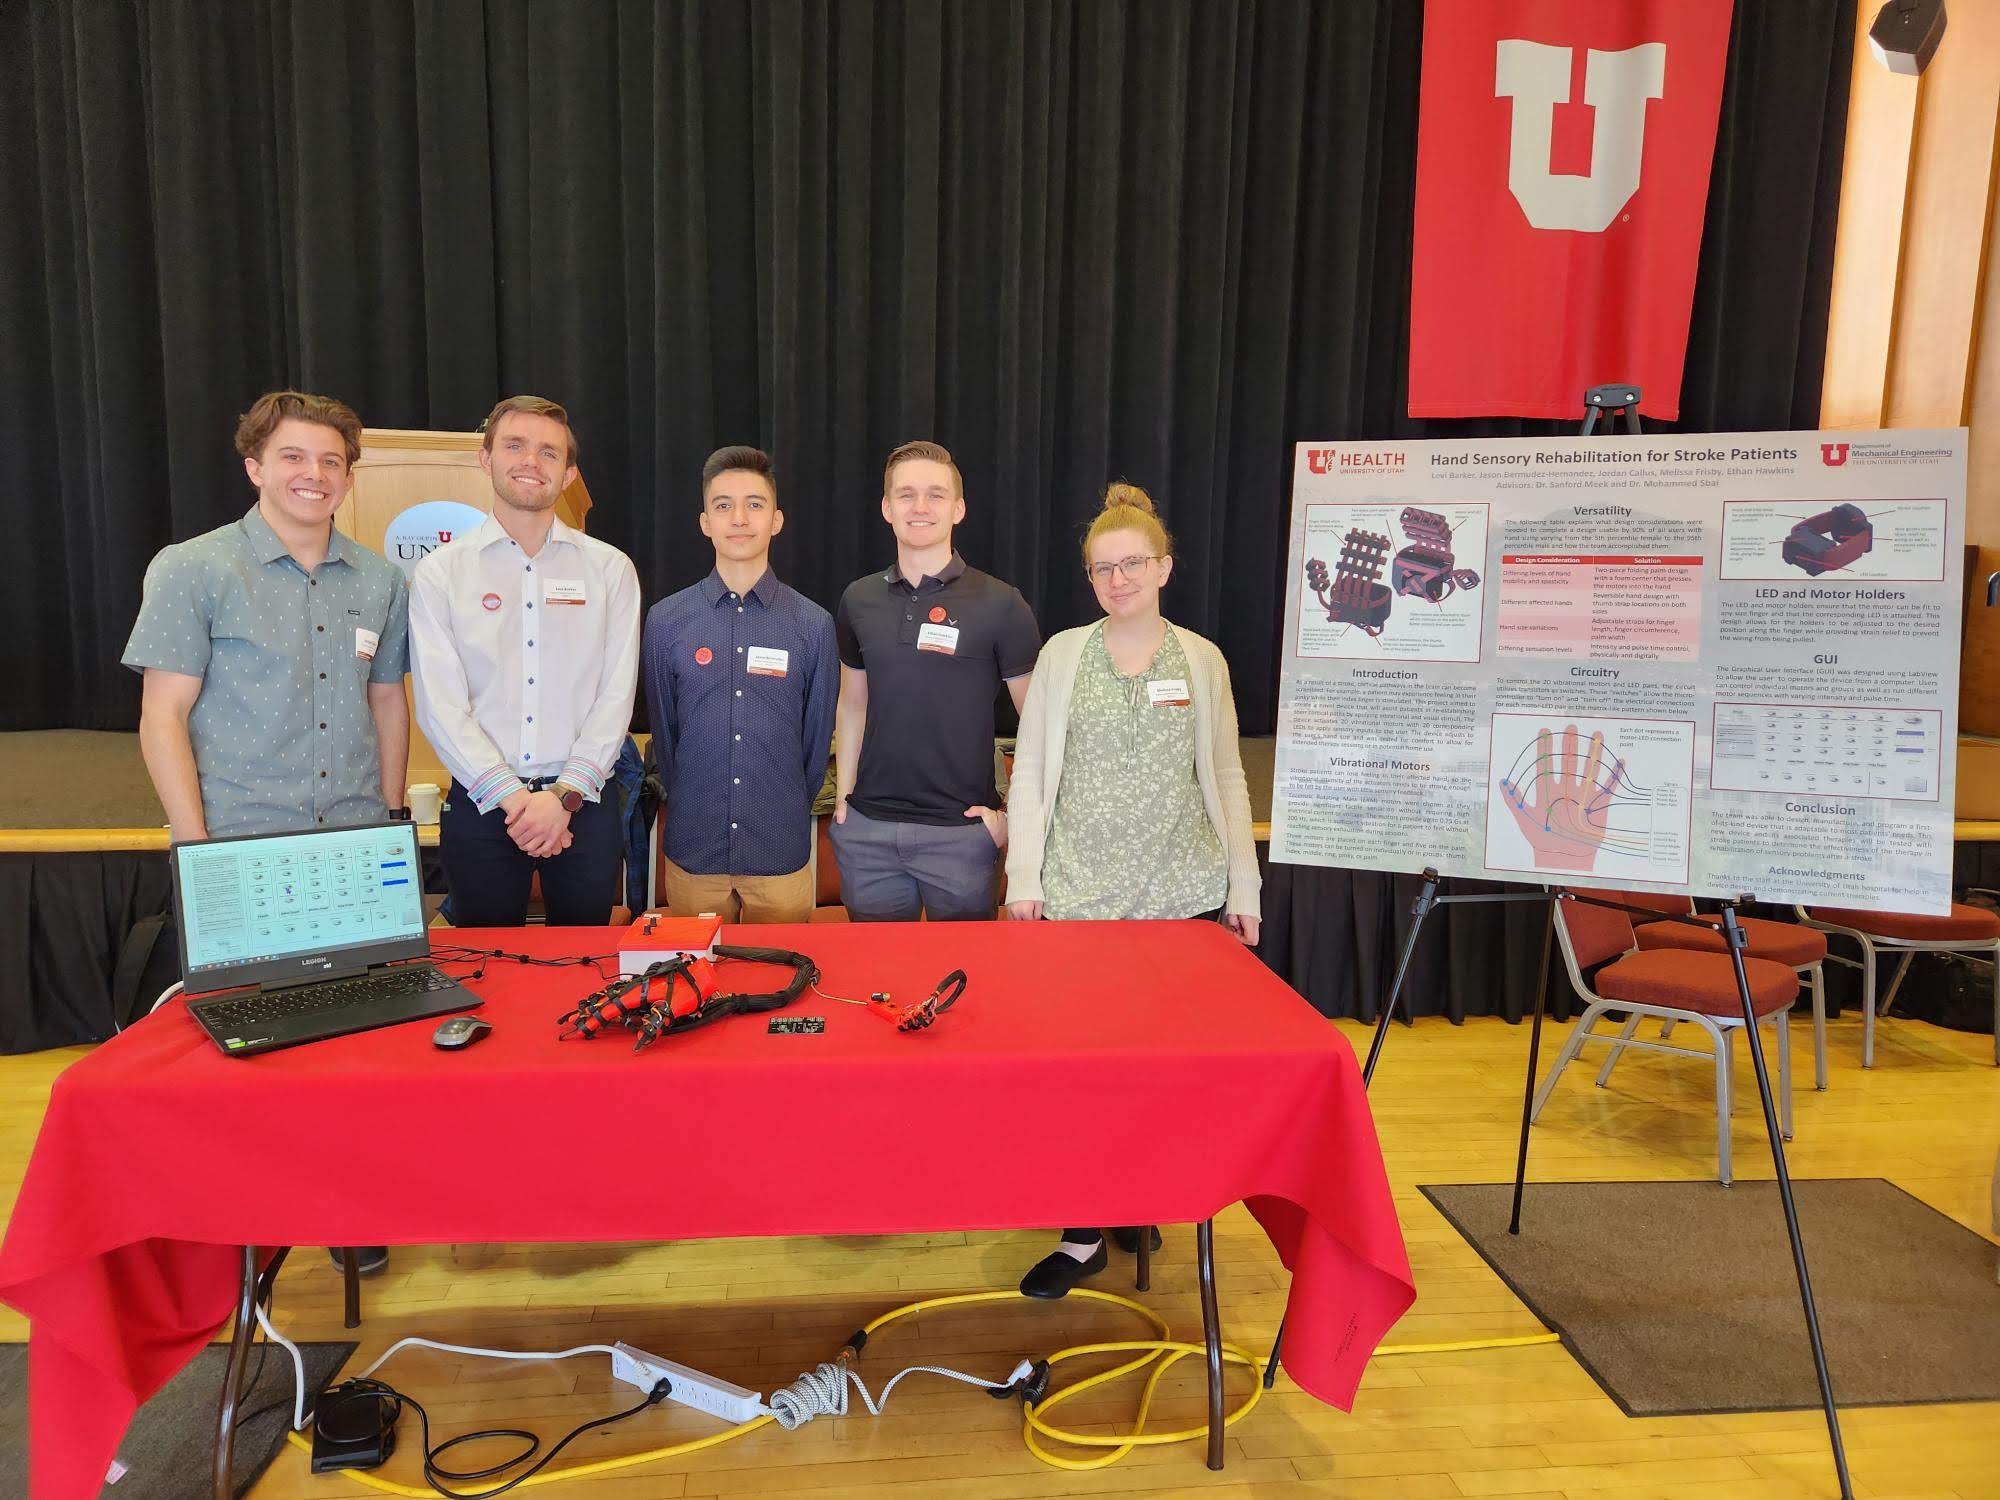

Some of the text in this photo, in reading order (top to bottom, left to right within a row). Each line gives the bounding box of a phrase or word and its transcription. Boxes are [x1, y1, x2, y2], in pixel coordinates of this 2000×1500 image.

[1494, 39, 1667, 232] U
[1431, 448, 1797, 467] Hand Sensory Rehabilitation for Stroke Patients
[1820, 443, 1850, 466] U
[1900, 449, 1952, 458] Engineering
[1339, 453, 1406, 466] HEALTH
[1431, 471, 1447, 479] Levi
[1478, 470, 1502, 478] Jason
[1597, 469, 1627, 477] Jordan
[1659, 468, 1694, 476] Melissa
[1695, 467, 1725, 477] Frisby,
[1726, 467, 1754, 475] Ethan
[1755, 466, 1794, 474] Hawkins
[1496, 481, 1534, 489] Advisors:
[1584, 480, 1609, 488] Meek
[1610, 480, 1627, 488] and
[1628, 480, 1642, 488] Dr.
[1573, 506, 1632, 518] Versatility
[438, 532, 452, 543] U
[1515, 557, 1536, 565] Design
[1503, 570, 1529, 578] Differing
[1595, 567, 1626, 575] Two-piece
[1627, 567, 1649, 575] folding
[1649, 567, 1666, 575] palm
[1642, 593, 1664, 601] design
[1755, 589, 1905, 599] LED and Motor Holders
[1591, 618, 1624, 626] Adjustable
[1625, 618, 1644, 626] straps
[1720, 618, 1741, 626] design
[1853, 620, 1882, 628] adjusted
[1591, 626, 1612, 634] length,
[1613, 626, 1632, 634] finger
[1590, 634, 1607, 642] palm
[1590, 644, 1617, 652] Intensity
[1631, 644, 1649, 652] pulse
[1633, 652, 1659, 660] digitally
[1814, 654, 1838, 664] GUI
[1352, 668, 1418, 679] Introduction
[1570, 667, 1620, 679] Circuitry
[1790, 693, 1816, 701] varying
[1816, 694, 1847, 702] intensity
[1862, 695, 1882, 703] pulse
[1330, 757, 1430, 771] Vibrational Motors
[1785, 802, 1856, 815] Conclusion
[1768, 866, 1866, 880] Acknowledgments
